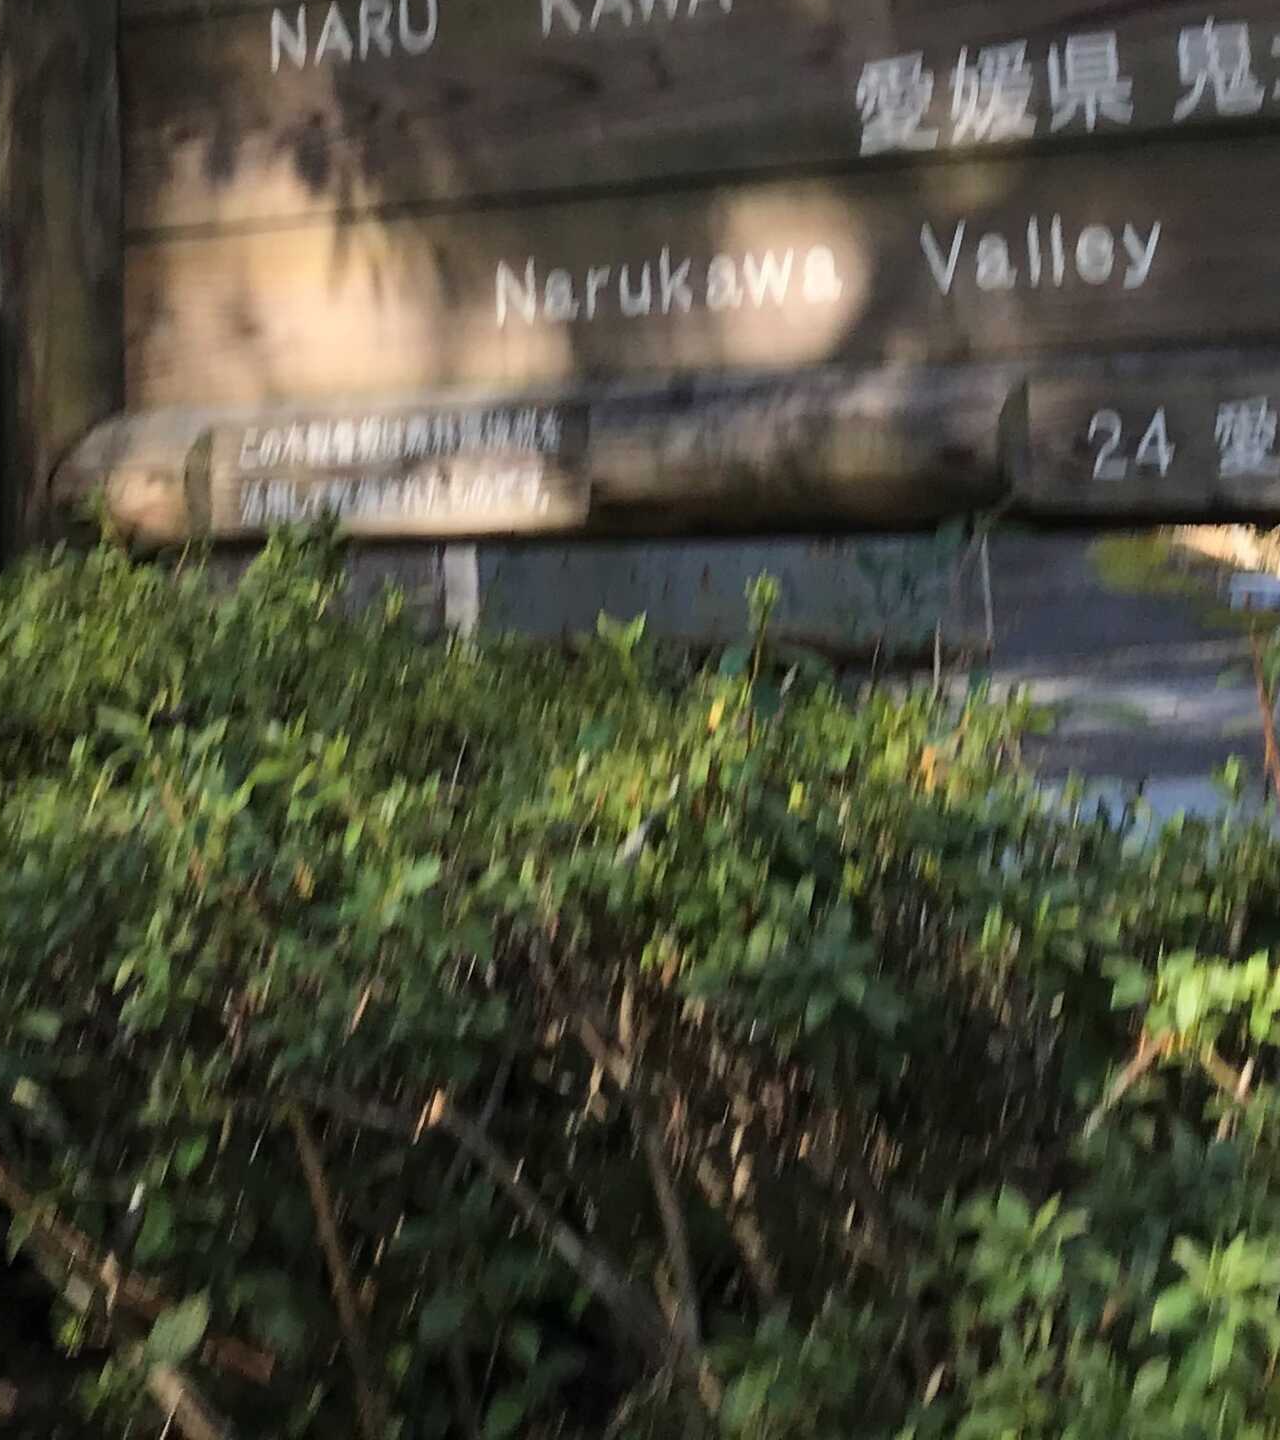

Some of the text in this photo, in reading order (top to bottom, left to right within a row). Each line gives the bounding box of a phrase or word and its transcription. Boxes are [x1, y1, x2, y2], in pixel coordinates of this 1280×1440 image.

[495, 213, 1162, 328] Narukawa Valley
[1087, 405, 1174, 480] 24
